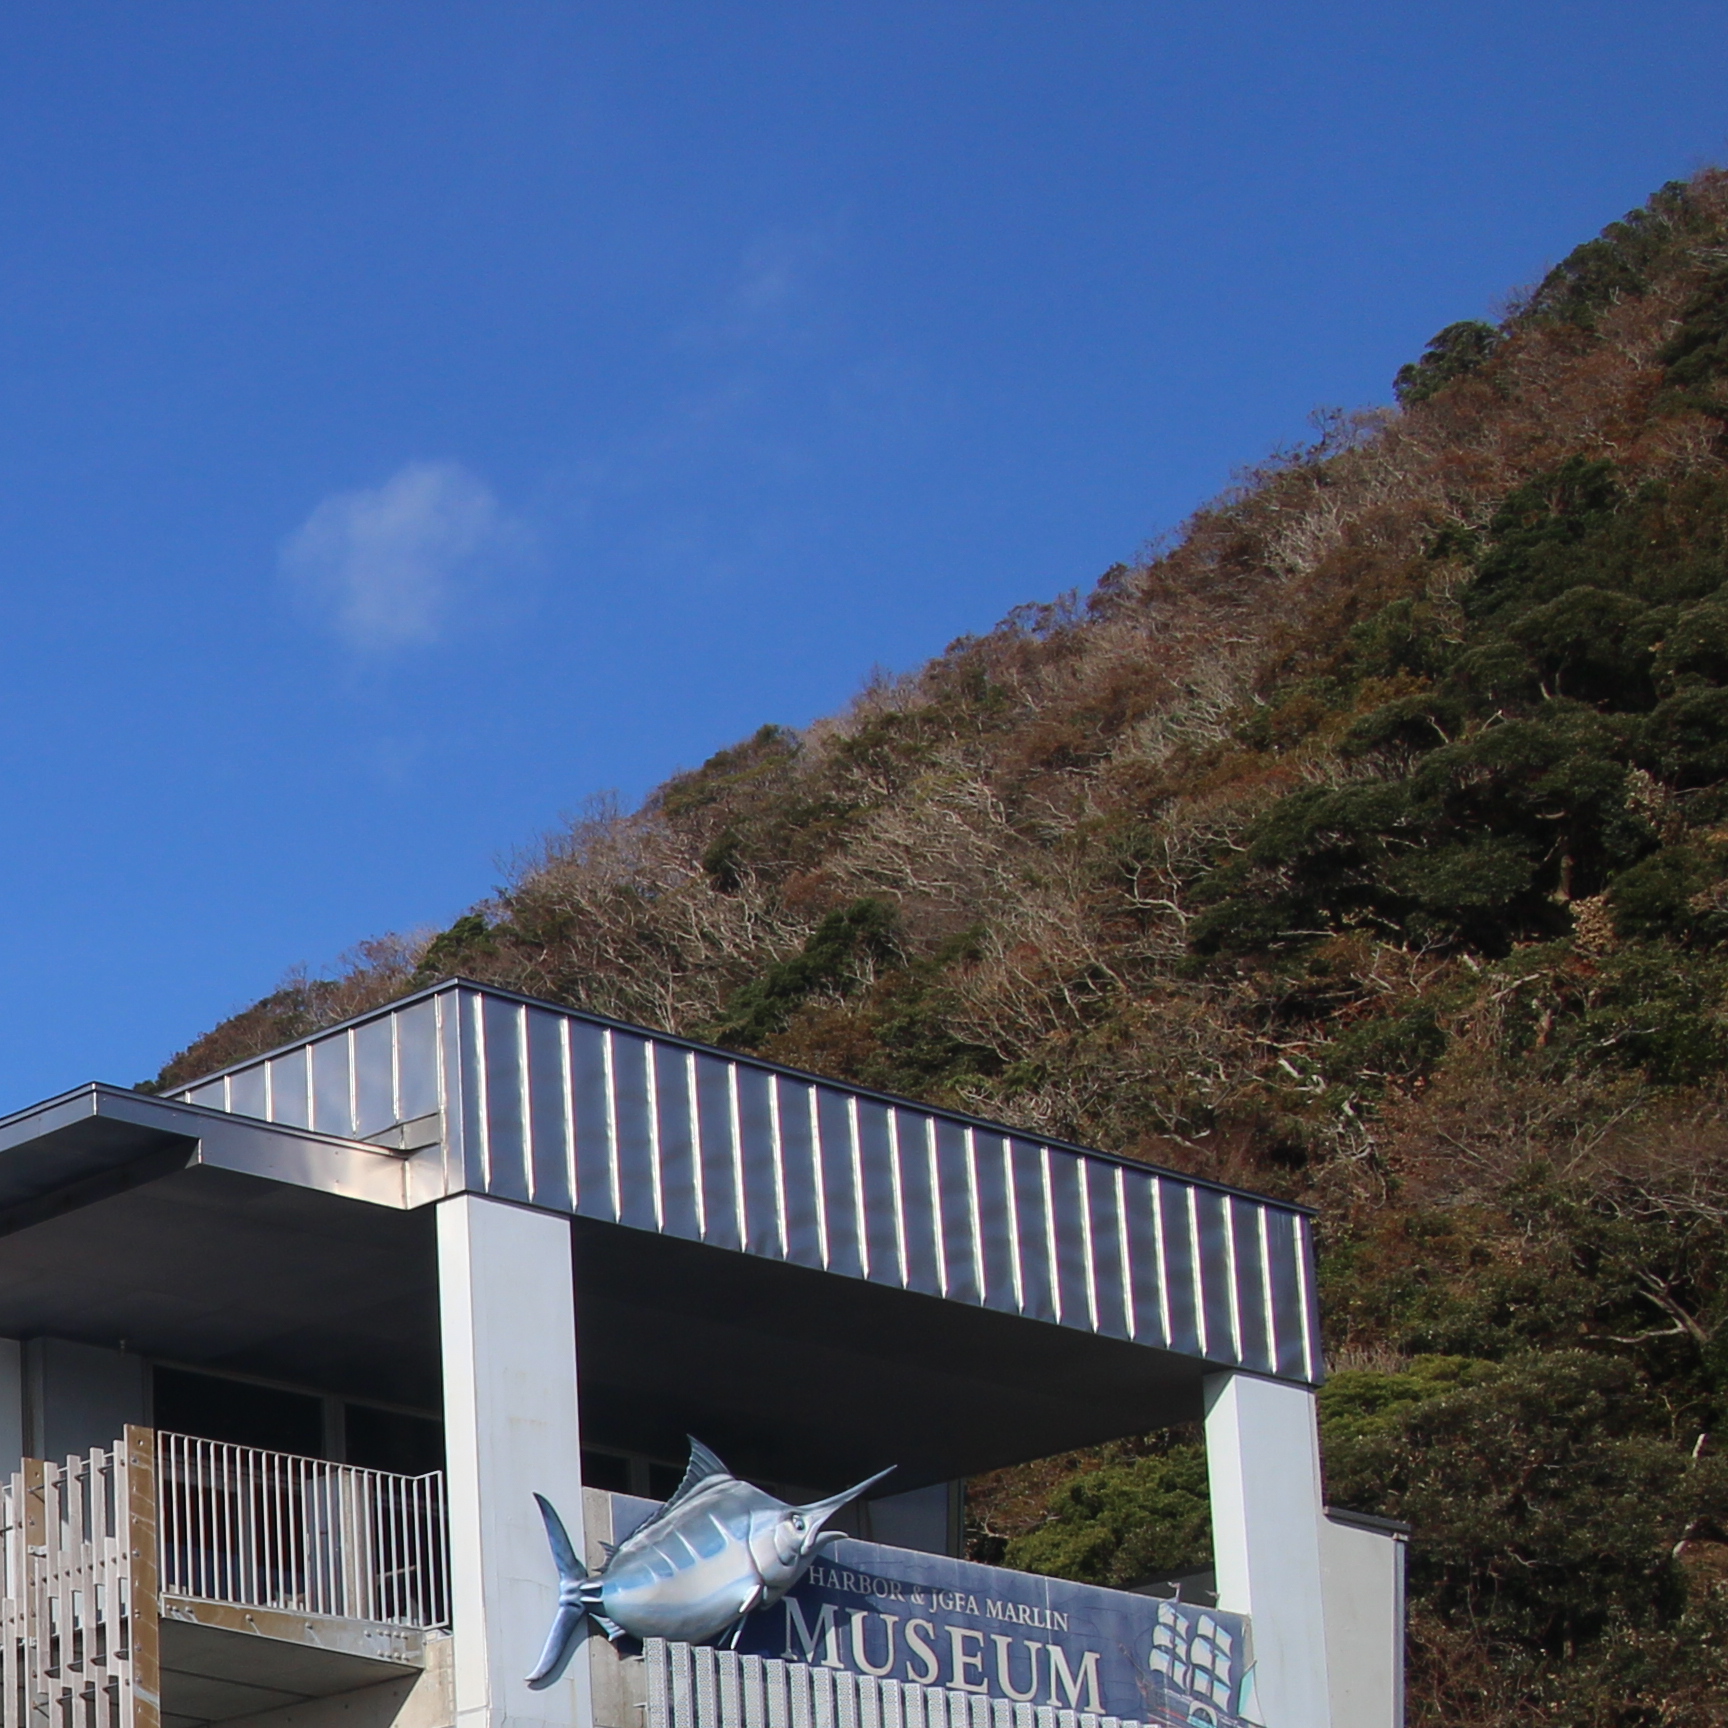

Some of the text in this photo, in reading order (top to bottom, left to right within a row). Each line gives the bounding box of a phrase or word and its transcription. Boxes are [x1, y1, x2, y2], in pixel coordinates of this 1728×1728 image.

[809, 1566, 1070, 1633] HARBOR & JGFA MARLIN
[780, 1595, 1107, 1716] MUSEUM
